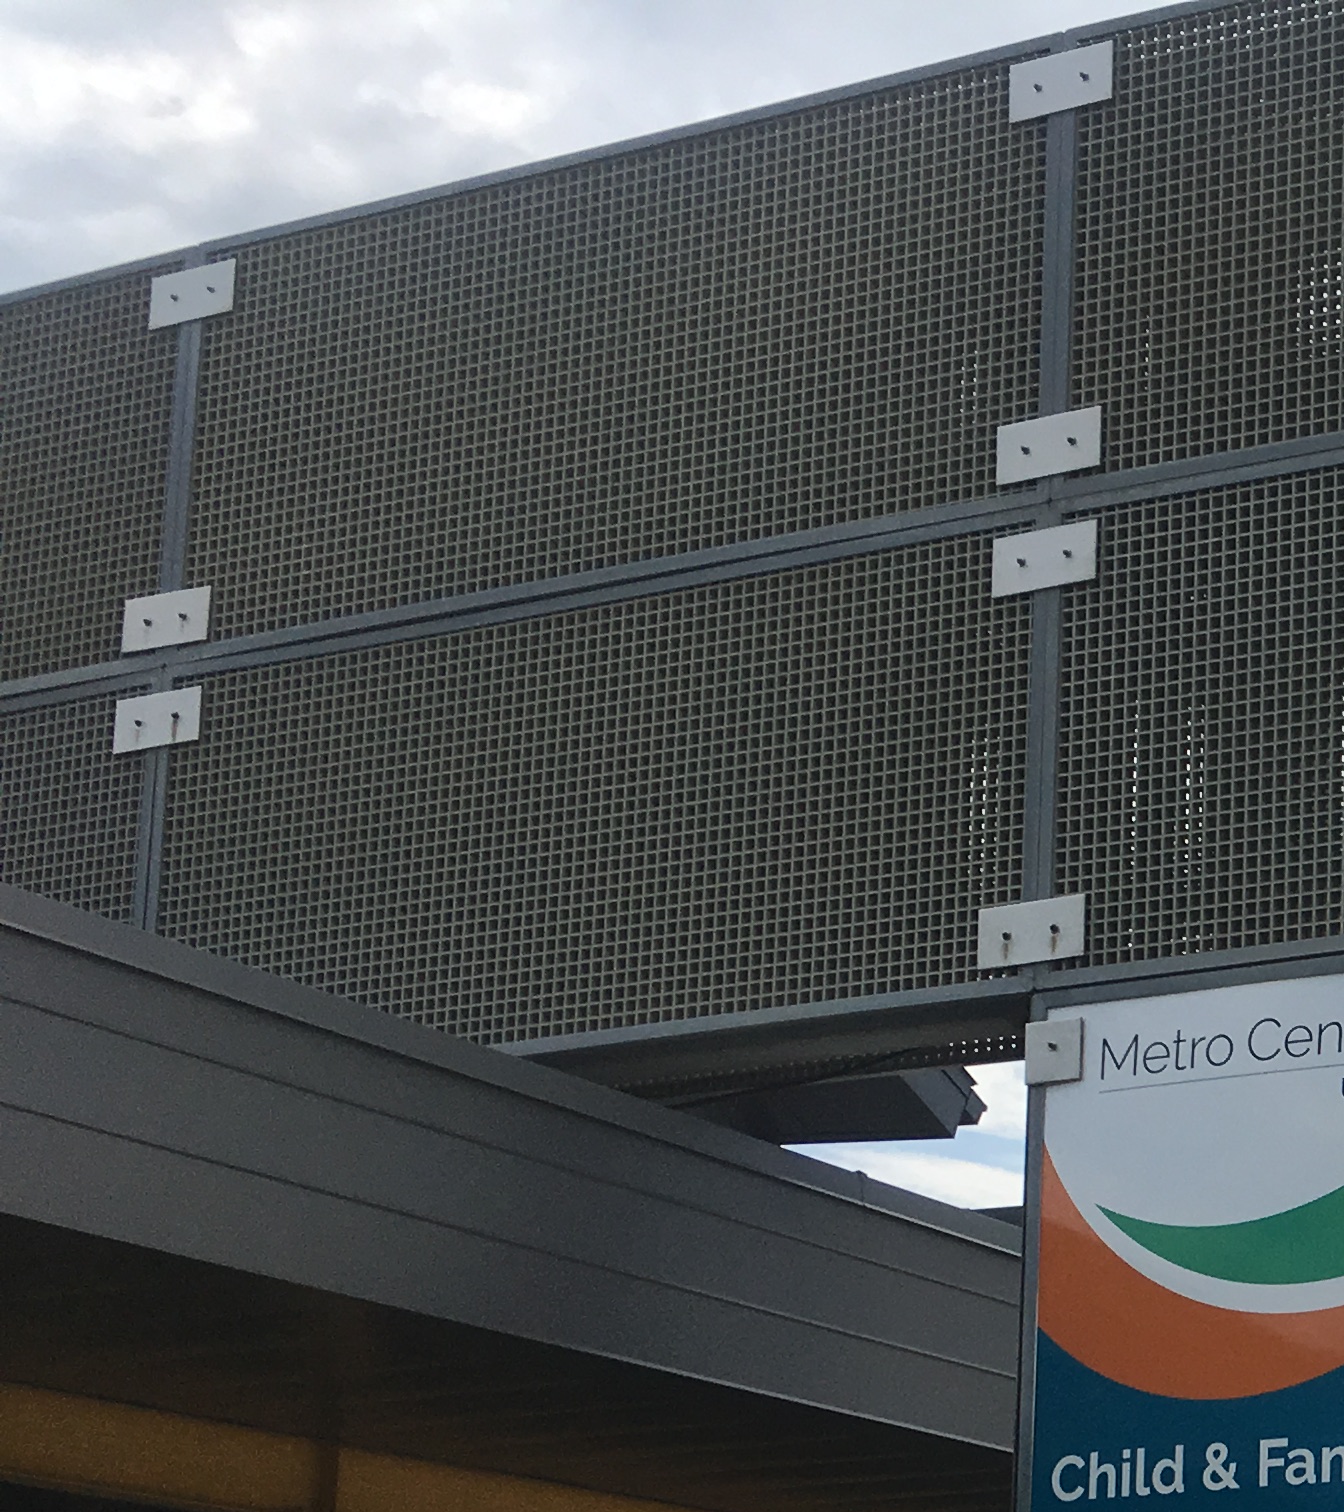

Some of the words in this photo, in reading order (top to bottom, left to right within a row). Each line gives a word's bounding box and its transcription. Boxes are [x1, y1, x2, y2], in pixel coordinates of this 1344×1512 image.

[1100, 1020, 1235, 1071] Metro
[1051, 1444, 1185, 1501] Child
[1202, 1442, 1240, 1491] &
